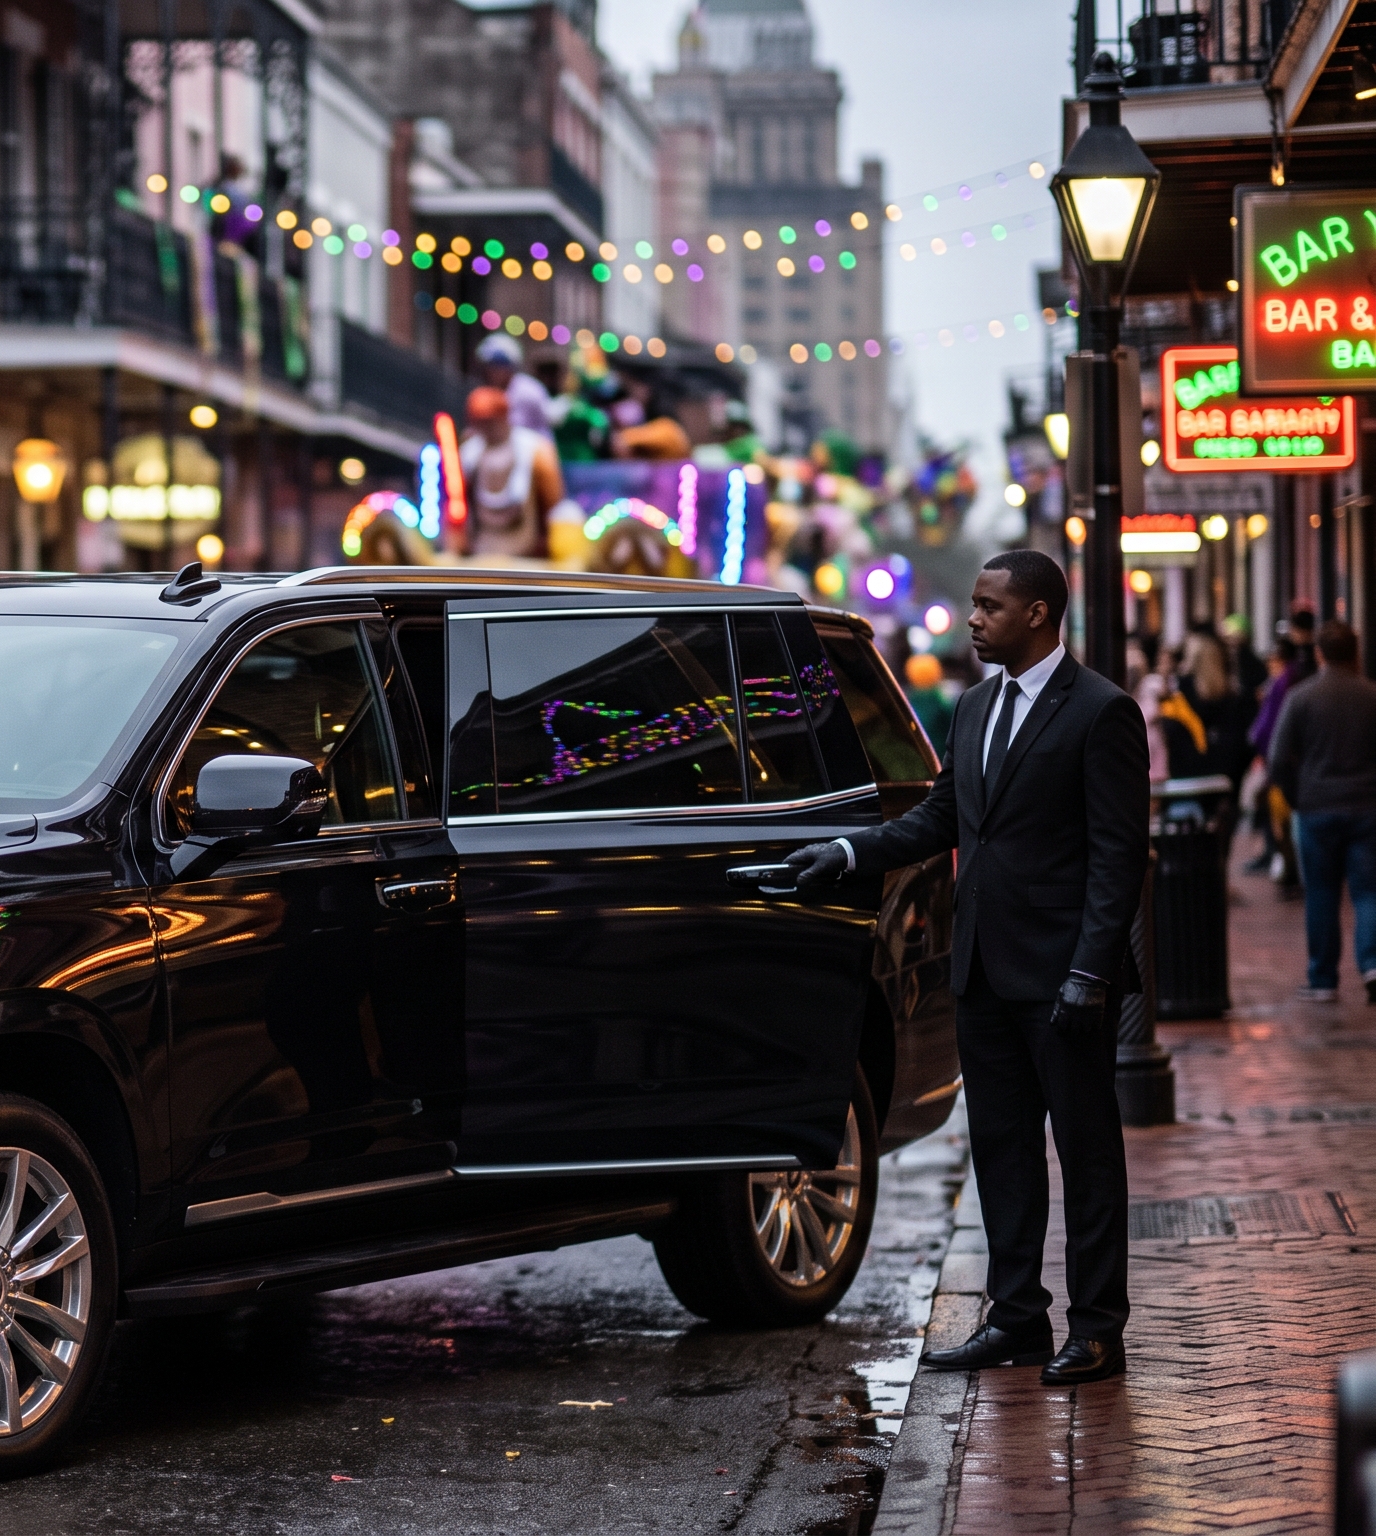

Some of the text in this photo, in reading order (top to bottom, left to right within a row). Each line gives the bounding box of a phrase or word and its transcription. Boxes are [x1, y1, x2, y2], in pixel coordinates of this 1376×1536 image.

[1260, 217, 1354, 287] BAR
[1265, 296, 1376, 333] BAR &
